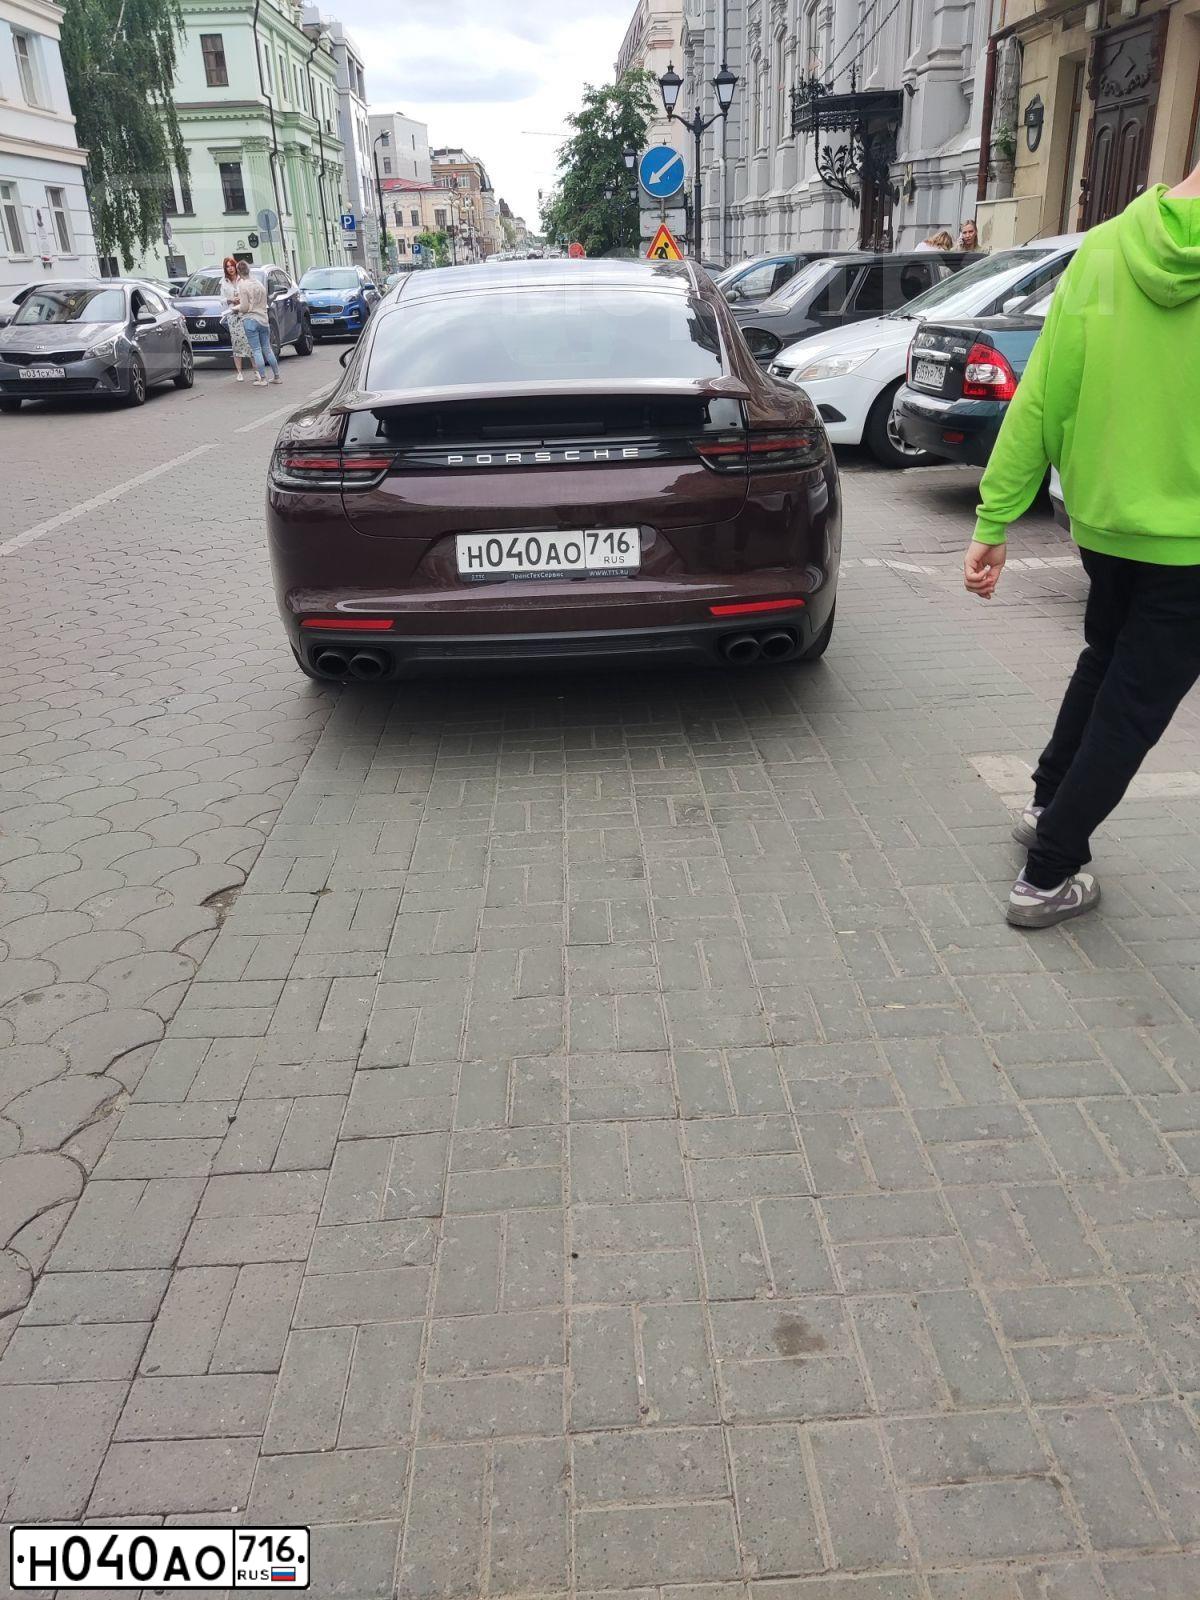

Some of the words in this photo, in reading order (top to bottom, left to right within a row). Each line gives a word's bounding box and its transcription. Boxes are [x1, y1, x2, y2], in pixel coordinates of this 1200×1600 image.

[447, 448, 638, 465] PORSCHE
[467, 536, 582, 568] Н040АО
[586, 531, 631, 555] 716
[604, 555, 625, 564] RUS
